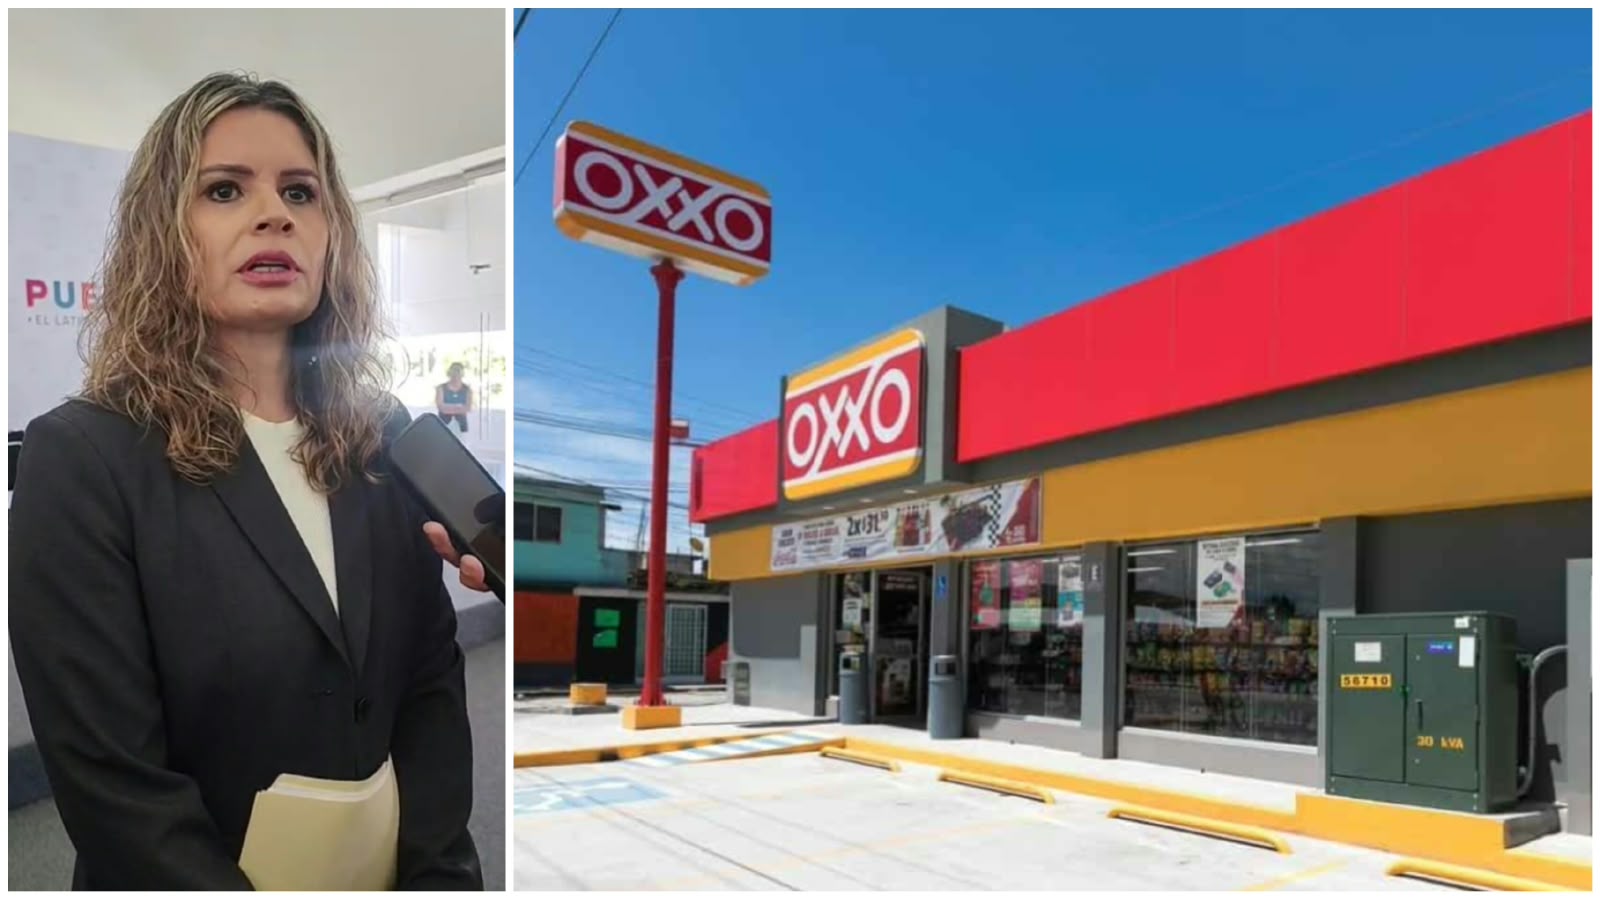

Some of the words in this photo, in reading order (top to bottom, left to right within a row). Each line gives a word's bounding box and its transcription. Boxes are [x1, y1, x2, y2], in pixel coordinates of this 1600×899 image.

[574, 151, 763, 251] OXXO
[788, 366, 911, 478] OXXO
[1343, 675, 1389, 687] 56710
[1417, 735, 1434, 748] 30
[1441, 736, 1464, 749] kVA
